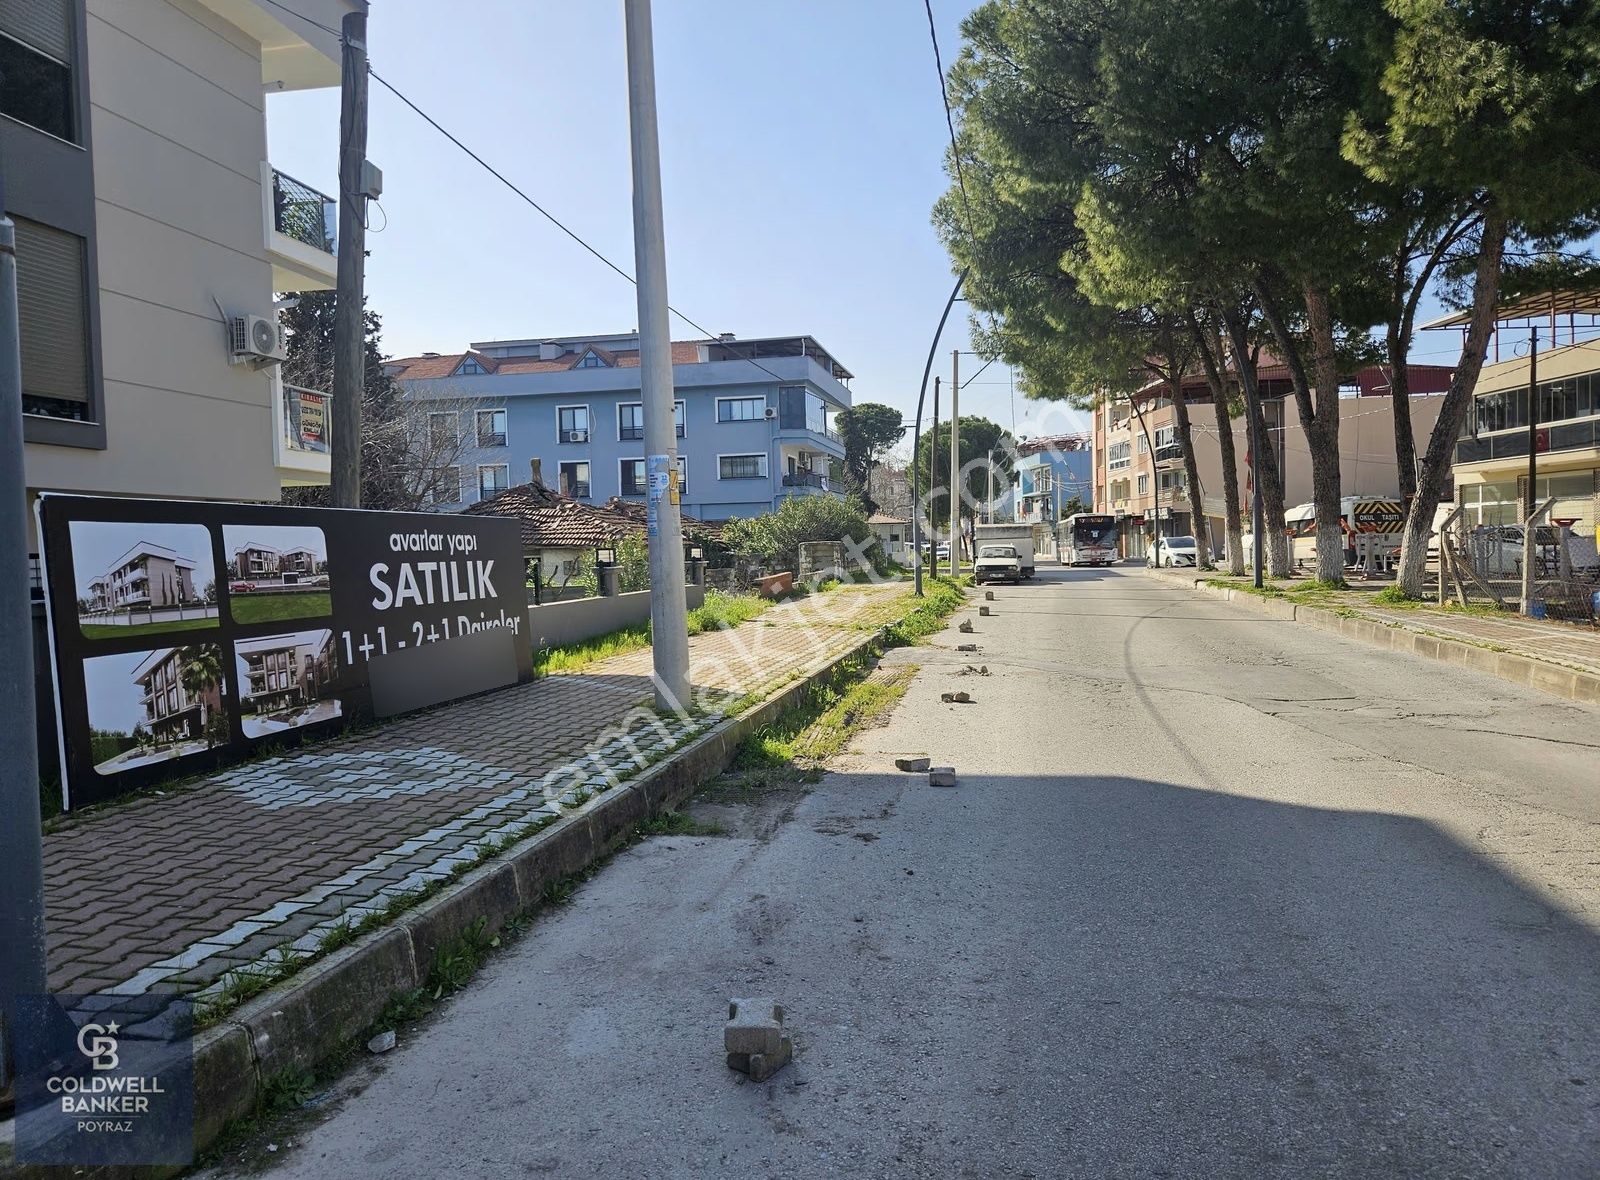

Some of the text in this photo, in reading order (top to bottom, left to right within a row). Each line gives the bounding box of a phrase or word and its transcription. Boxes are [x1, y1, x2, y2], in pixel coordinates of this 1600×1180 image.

[389, 529, 477, 555] avarlar yapı
[369, 560, 498, 610] SATILIK
[342, 626, 388, 665] 1+1
[398, 640, 406, 648] -
[412, 617, 450, 647] 2+1
